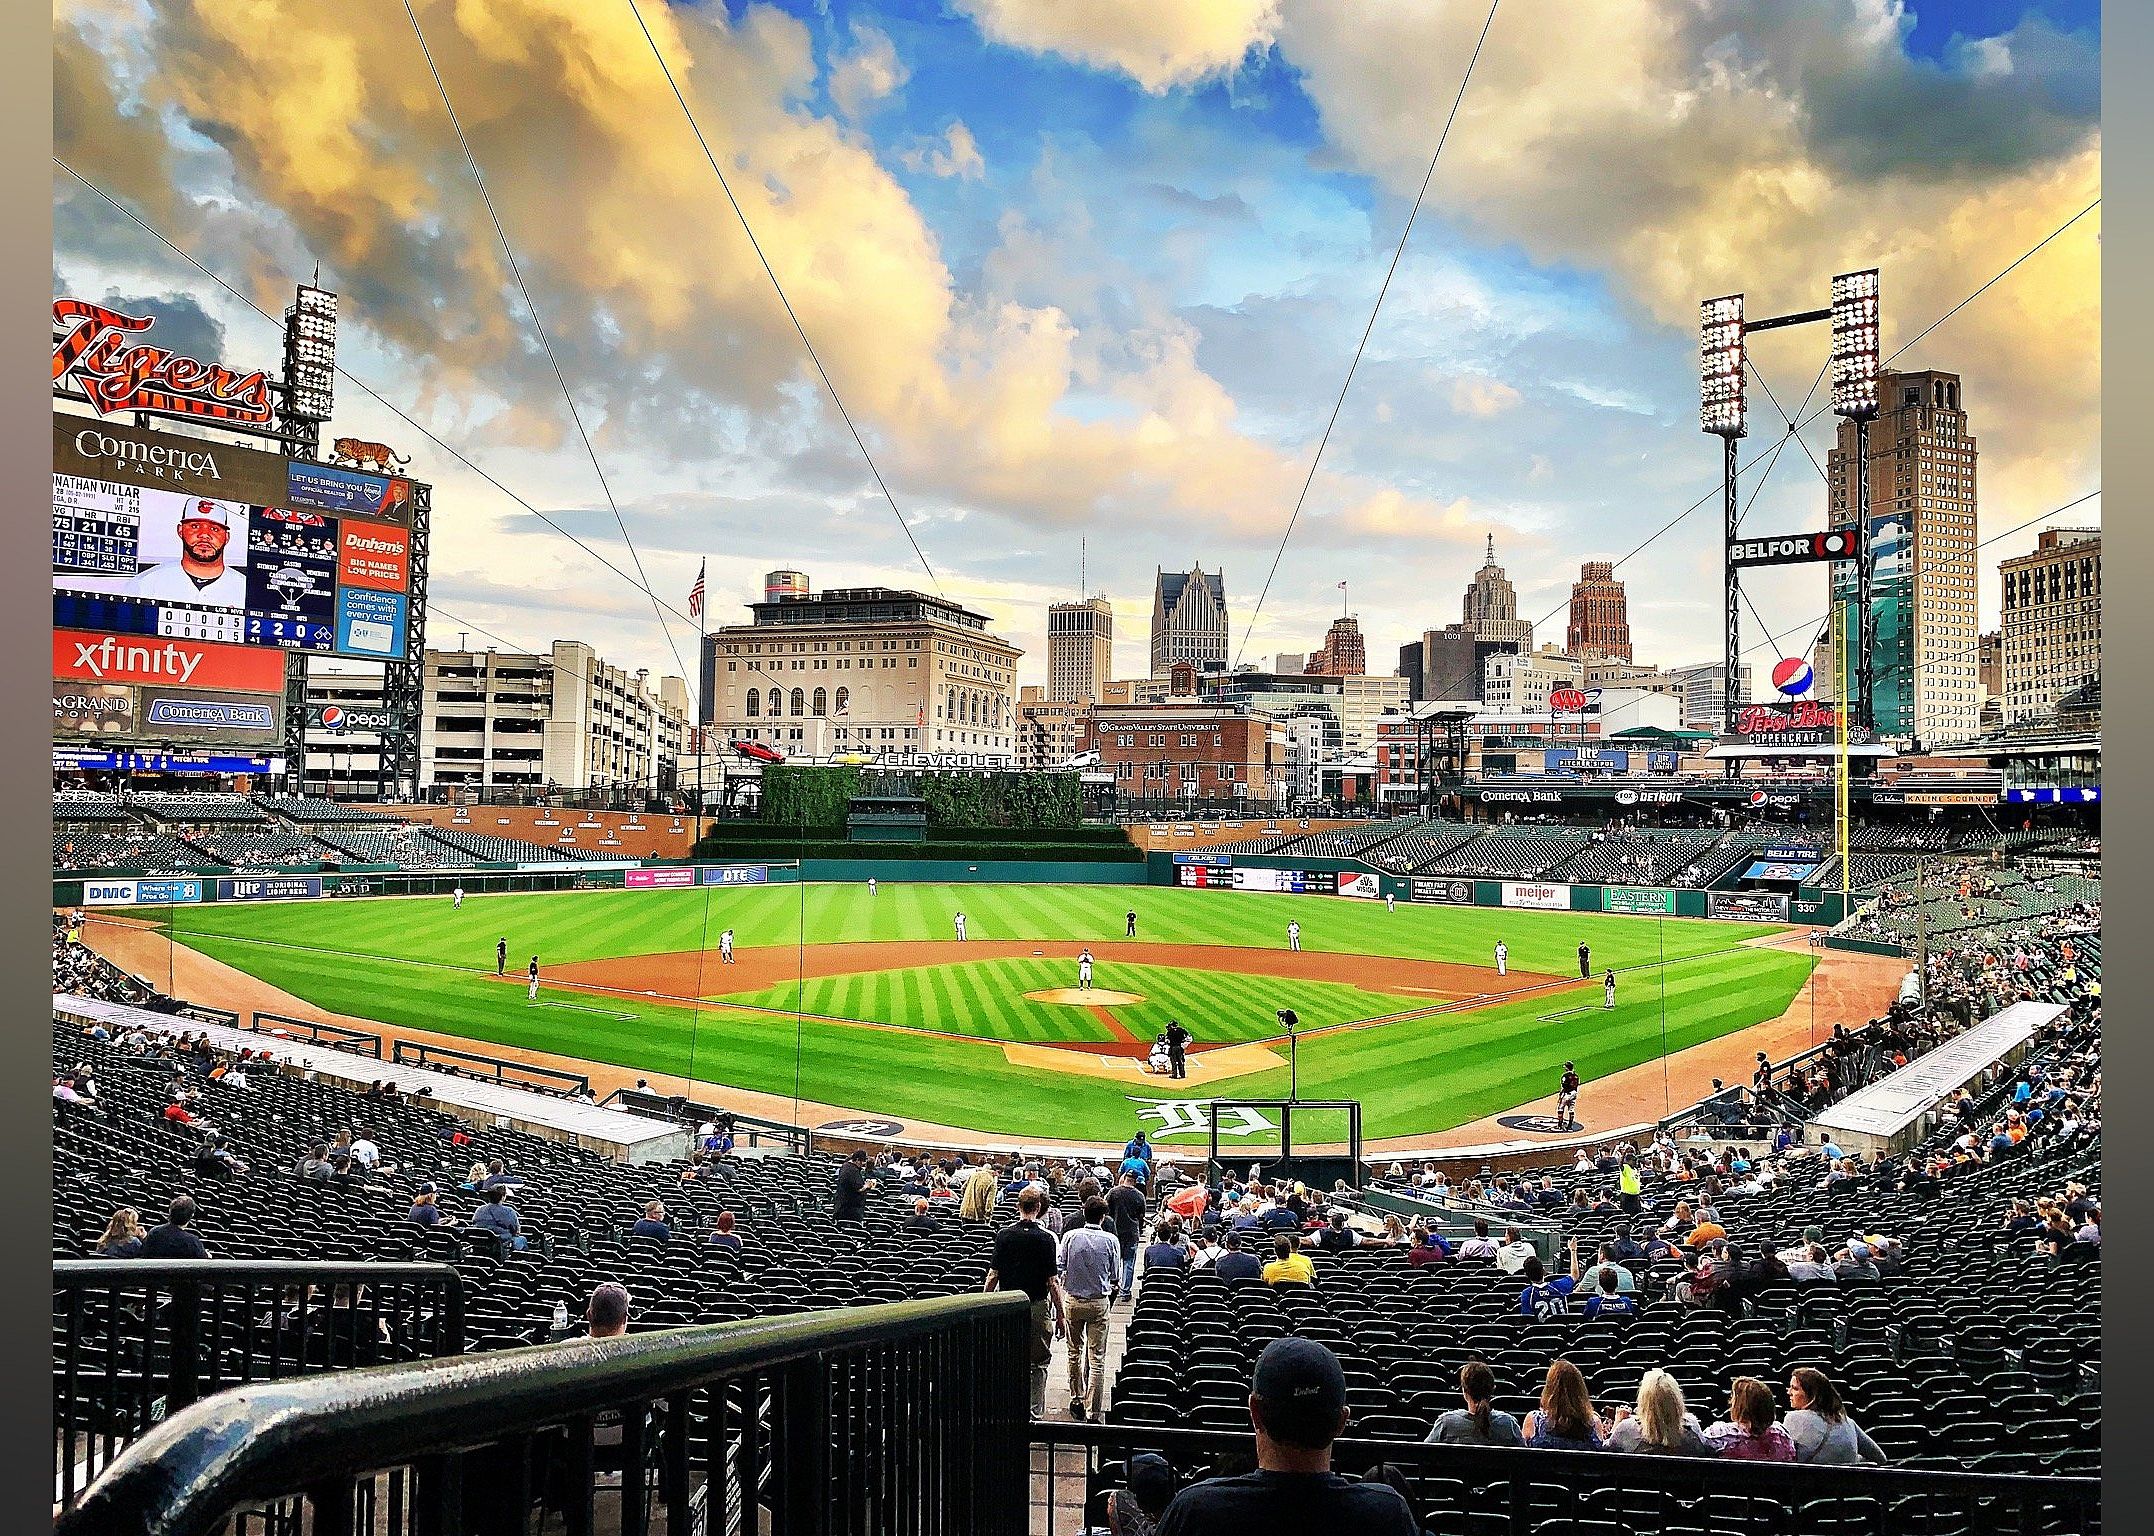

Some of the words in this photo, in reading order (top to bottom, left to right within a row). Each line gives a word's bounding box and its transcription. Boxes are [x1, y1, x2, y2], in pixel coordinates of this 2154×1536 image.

[53, 299, 274, 421] Tigers
[116, 460, 184, 481] PARK
[53, 474, 97, 493] NATHAN
[100, 482, 140, 499] VILLAR
[291, 474, 306, 482] LET
[308, 477, 318, 485] US
[320, 479, 345, 489] BRING
[347, 483, 363, 492] YOU
[53, 506, 66, 515] VG
[84, 512, 97, 520] HR
[116, 515, 131, 524] RBI
[240, 505, 245, 515] 2
[82, 521, 97, 533] 21
[115, 526, 131, 537] 65
[346, 534, 405, 555] Dunham's
[1731, 539, 1810, 560] BELFOR
[350, 558, 366, 568] BIG
[368, 561, 399, 571] NAMES
[348, 566, 367, 576] LOW
[369, 569, 400, 580] PRICES
[347, 590, 397, 604] Confidence
[347, 602, 376, 611] comes
[378, 604, 397, 614] with
[166, 611, 173, 620] 0
[185, 613, 190, 622] 0
[202, 614, 207, 624] 0
[218, 616, 223, 625] 0
[234, 618, 239, 628] 5
[347, 611, 371, 622] every
[165, 625, 172, 634] 0
[185, 627, 190, 637] 0
[201, 628, 207, 638] 0
[218, 630, 223, 640] 0
[234, 632, 239, 641] 5
[251, 620, 261, 634] 2
[273, 623, 283, 636] 2
[296, 625, 306, 638] 0
[1443, 633, 1461, 641] 1001
[73, 637, 204, 683] xfinity
[229, 709, 264, 721] Bank
[347, 712, 390, 729] pepsi
[1109, 723, 1134, 731] GRAND
[1133, 723, 1156, 731] VALLEY
[1156, 723, 1178, 731] STATE
[1178, 723, 1220, 731] UNIVERSITY
[1749, 732, 1823, 743] COPPERCRAFT
[884, 752, 1011, 768] CHEVROLET
[1533, 791, 1562, 802] Bank
[1619, 792, 1632, 800] FOX
[1640, 792, 1683, 802] DETROIT
[1769, 794, 1799, 804] pepsi
[456, 808, 468, 817] 23
[544, 810, 551, 819] 5
[587, 812, 593, 820] 2
[629, 814, 637, 823] 16
[674, 818, 679, 827] 6
[1267, 820, 1275, 829] 11
[1298, 820, 1309, 829] 42
[562, 828, 573, 837] 47
[607, 830, 614, 838] 3
[1767, 850, 1794, 859] BELLE
[1797, 851, 1818, 859] TIRE
[89, 887, 131, 899] DMC
[1356, 884, 1377, 894] VISION
[1515, 885, 1555, 900] meijer
[1611, 888, 1667, 902] EASTERN
[141, 892, 158, 900] Pros
